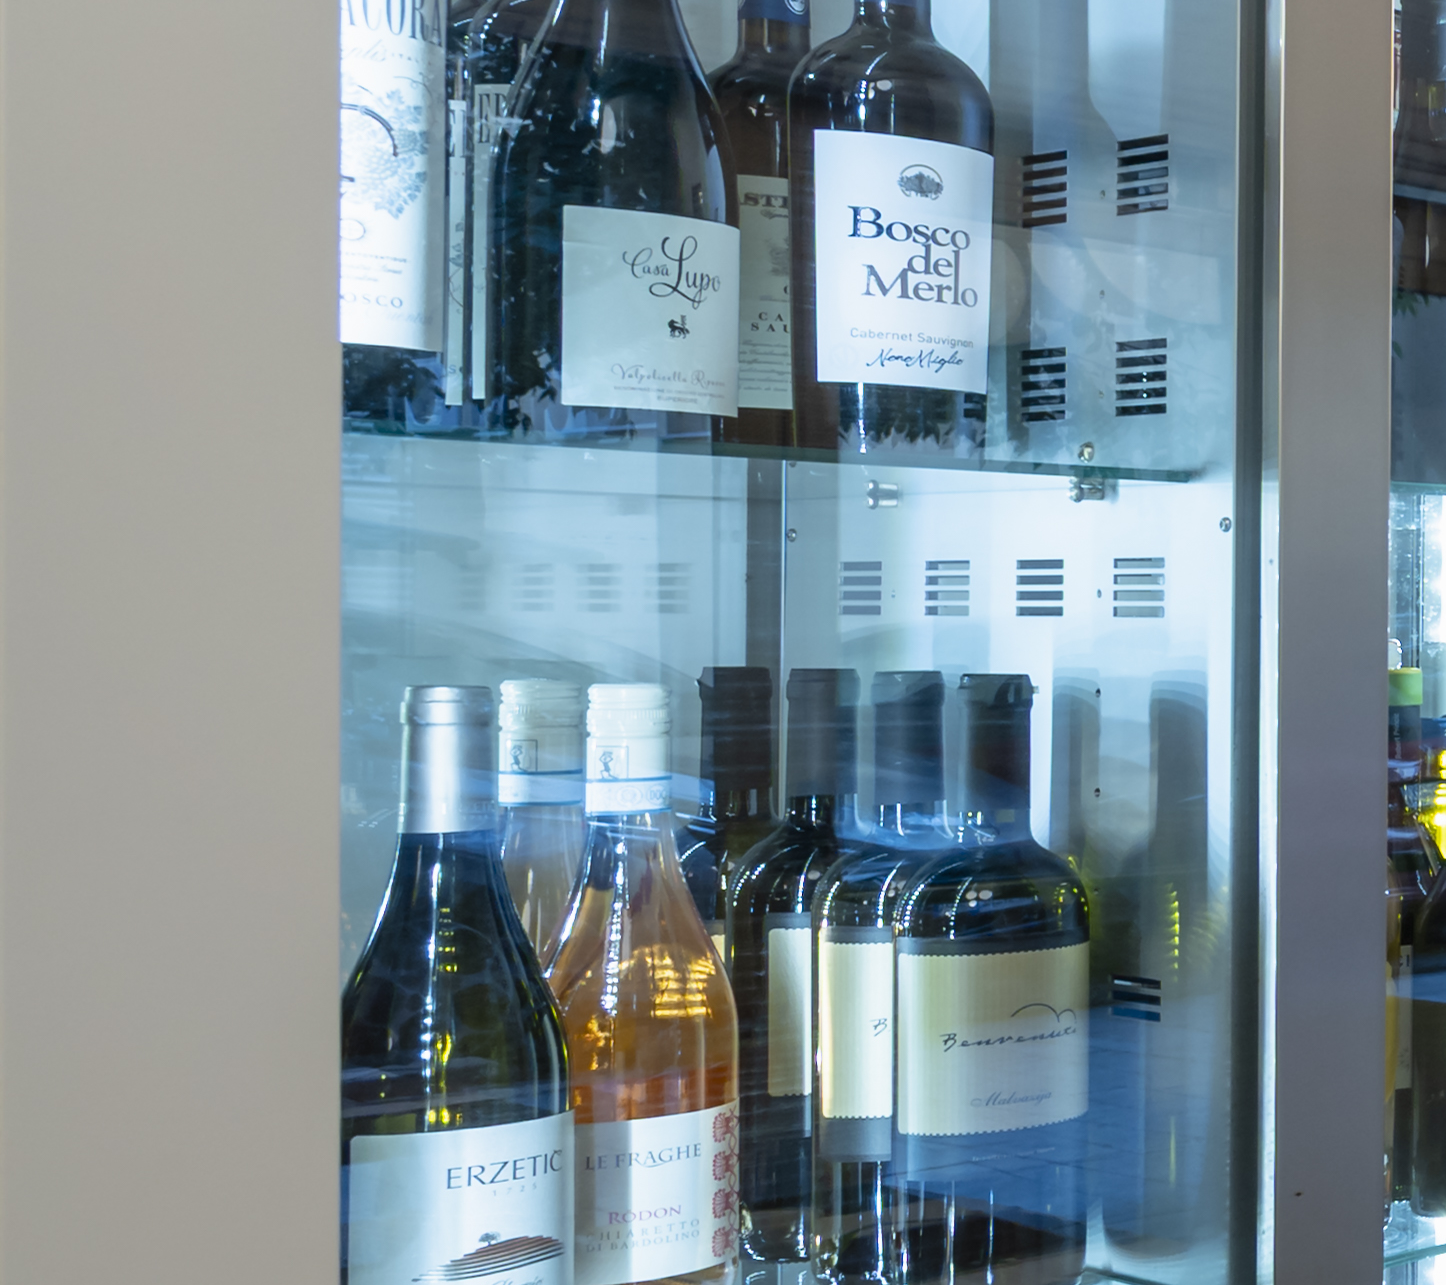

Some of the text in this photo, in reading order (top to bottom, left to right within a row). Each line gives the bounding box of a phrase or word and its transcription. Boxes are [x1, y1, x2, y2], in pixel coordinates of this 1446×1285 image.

[847, 205, 970, 250] Bosco
[622, 235, 721, 310] Casa Lupo
[907, 243, 960, 278] del
[861, 264, 978, 307] Merlo
[342, 292, 403, 309] OSCO
[850, 328, 974, 351] Cabernet Sauvignon
[585, 1142, 702, 1171] LE FRAGHE
[492, 1181, 539, 1197] 1725
[609, 1228, 701, 1252] BARDOLINO
